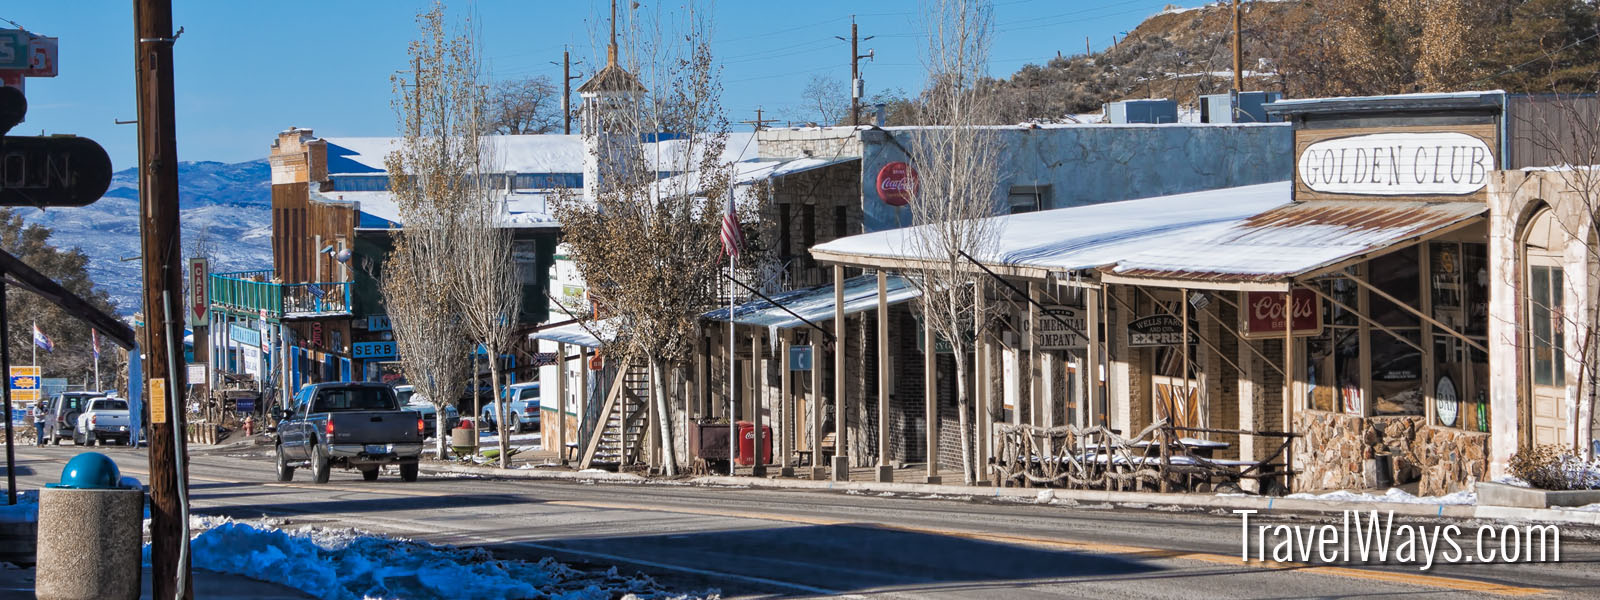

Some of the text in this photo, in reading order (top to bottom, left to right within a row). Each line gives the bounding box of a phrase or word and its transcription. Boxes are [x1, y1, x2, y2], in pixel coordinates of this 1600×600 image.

[1307, 145, 1486, 186] GOLDEN CLUB
[195, 267, 204, 304] CAFE
[1023, 318, 1087, 332] CMERCIAL
[1136, 317, 1162, 329] WELLS
[1272, 320, 1296, 329] BE
[1040, 334, 1077, 347] OMPANY
[1438, 393, 1456, 412] BAR
